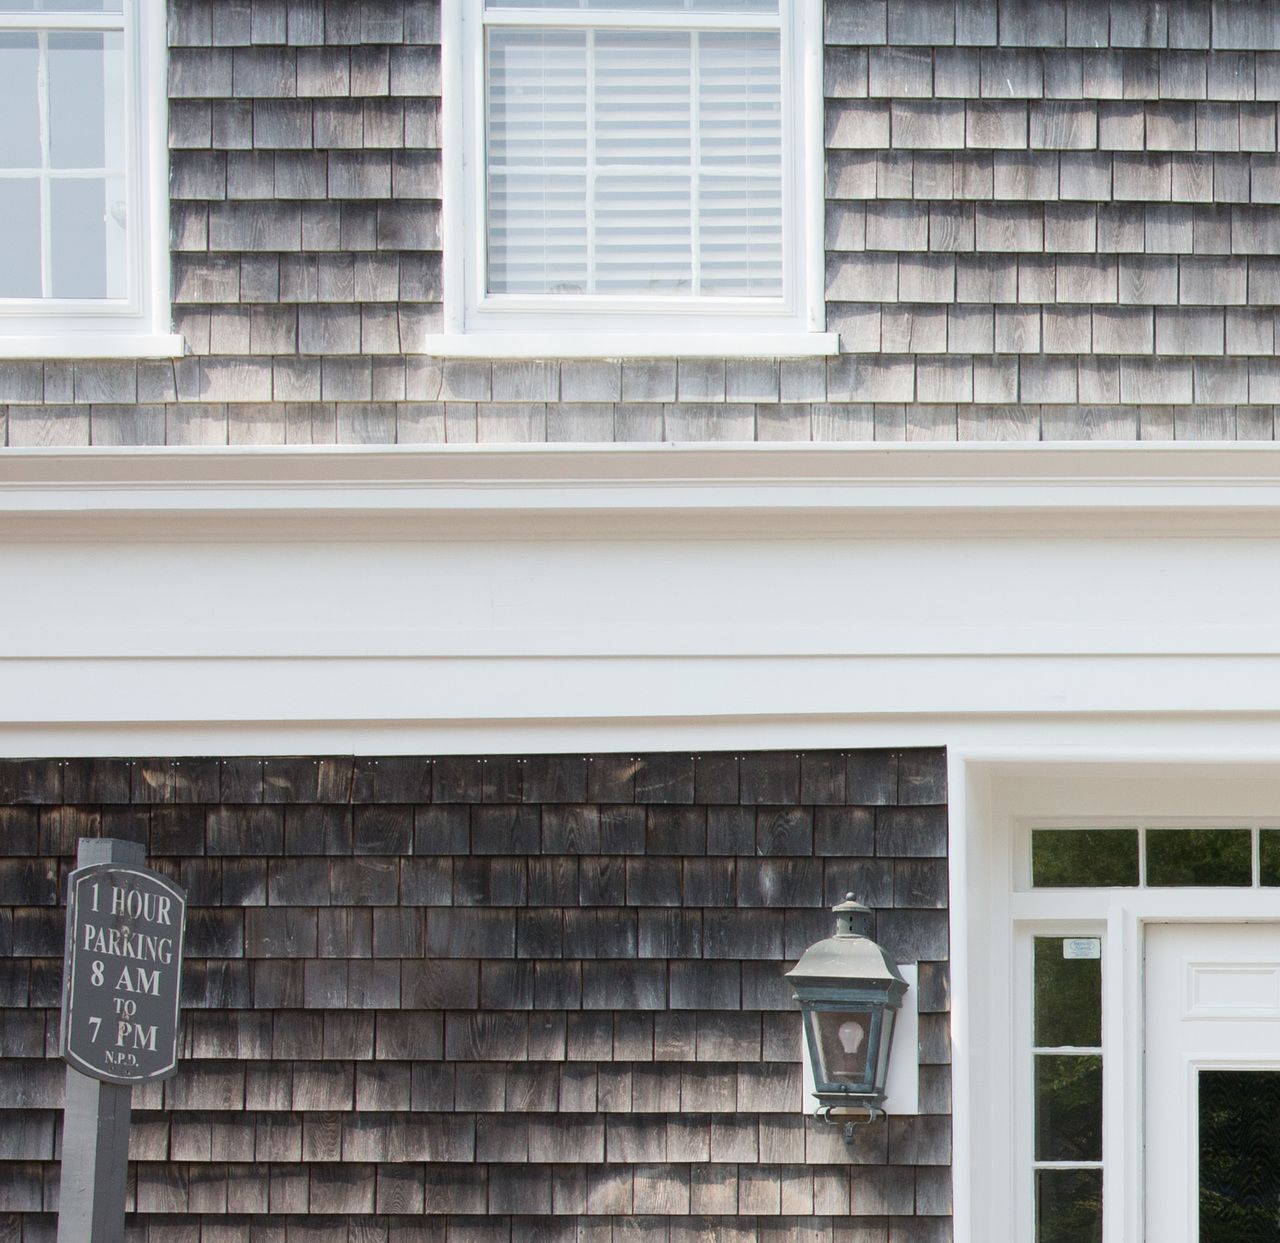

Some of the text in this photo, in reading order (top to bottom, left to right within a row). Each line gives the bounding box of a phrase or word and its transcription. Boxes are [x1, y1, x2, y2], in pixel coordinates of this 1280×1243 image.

[90, 883, 171, 926] 1 HOUR
[83, 923, 173, 965] PARKING
[91, 960, 162, 997] 8 AM
[113, 997, 137, 1017] TO
[88, 1016, 159, 1052] 7 PM
[104, 1050, 140, 1068] N.P.D.
